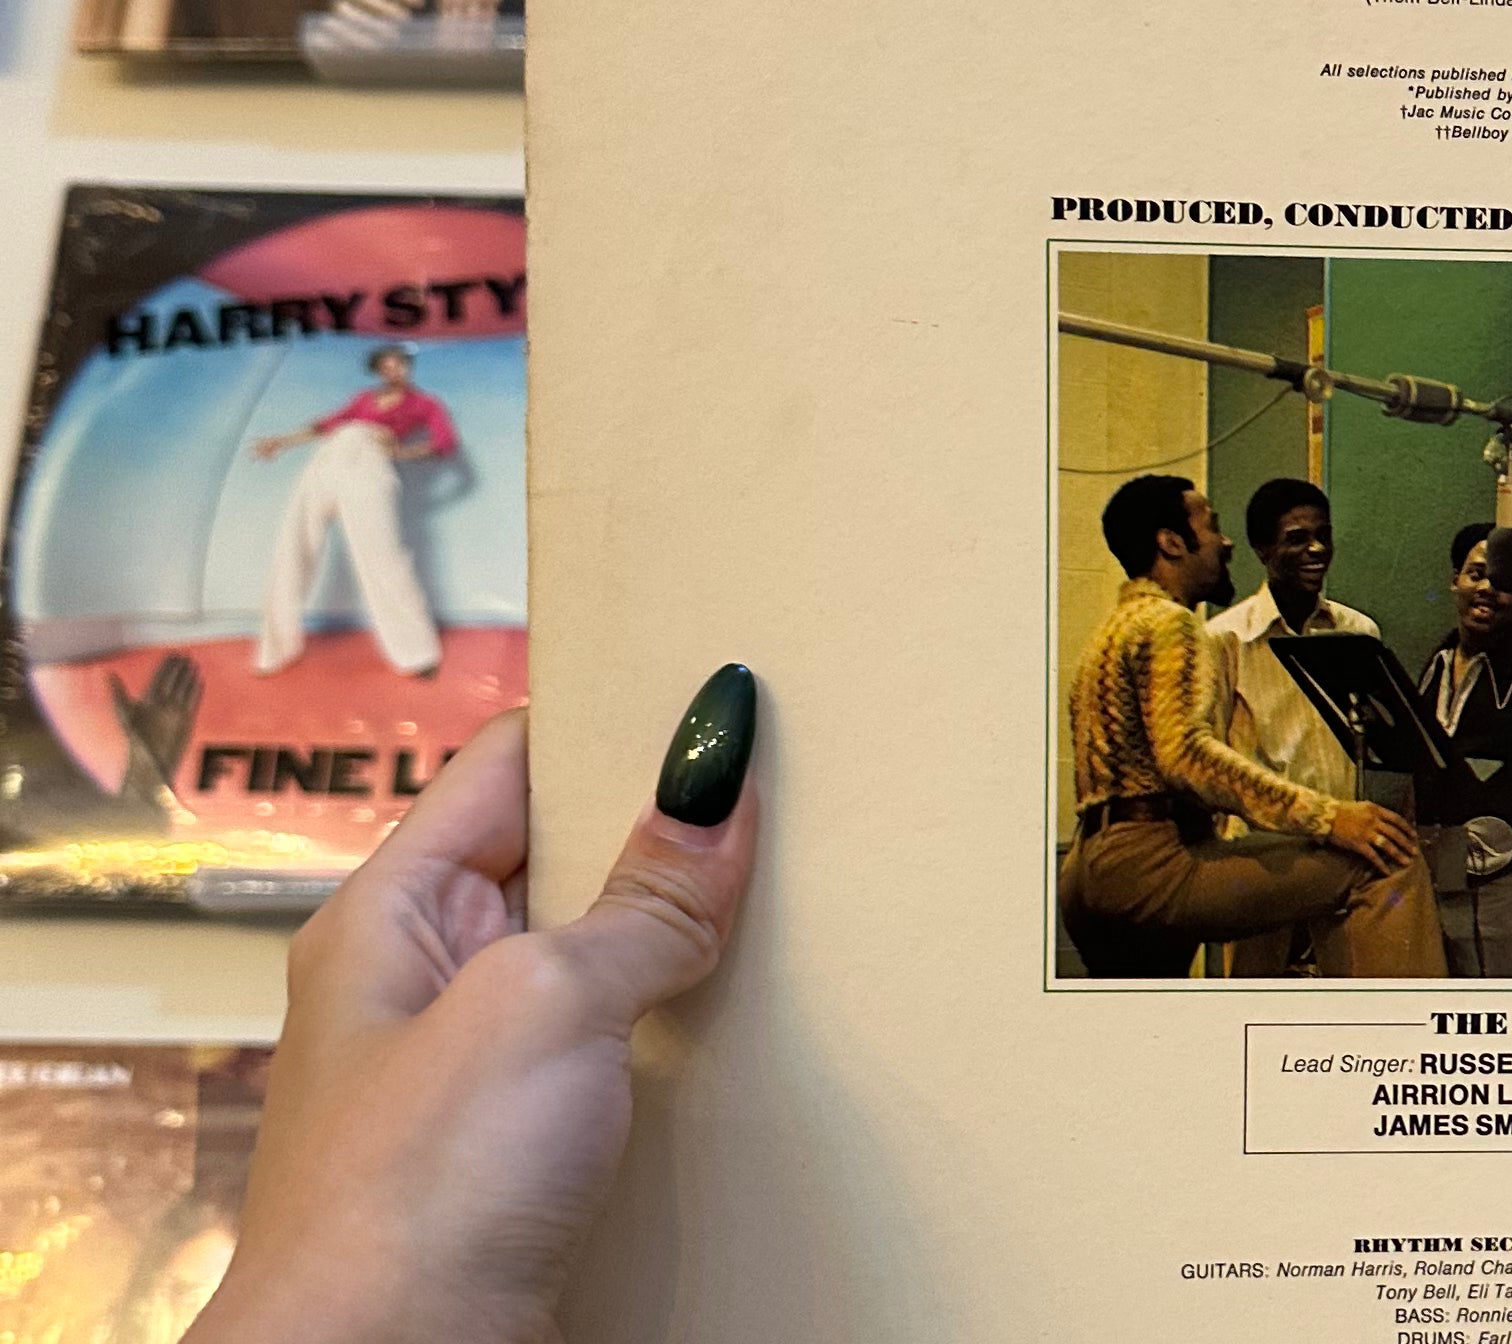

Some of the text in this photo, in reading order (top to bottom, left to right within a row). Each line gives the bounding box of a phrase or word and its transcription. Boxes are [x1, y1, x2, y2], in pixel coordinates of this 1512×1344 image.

[1051, 197, 1273, 230] PRODUCED,
[107, 291, 362, 355] HARRY
[198, 744, 376, 795] FINE
[1430, 1012, 1508, 1035] THE
[1281, 1054, 1334, 1072] Lead
[1340, 1055, 1415, 1077] Singer:
[1372, 1084, 1489, 1106] AIRRION
[1374, 1114, 1469, 1136] JAMES
[1353, 1238, 1463, 1253] RHYTHM
[1395, 1308, 1450, 1324] BASS:
